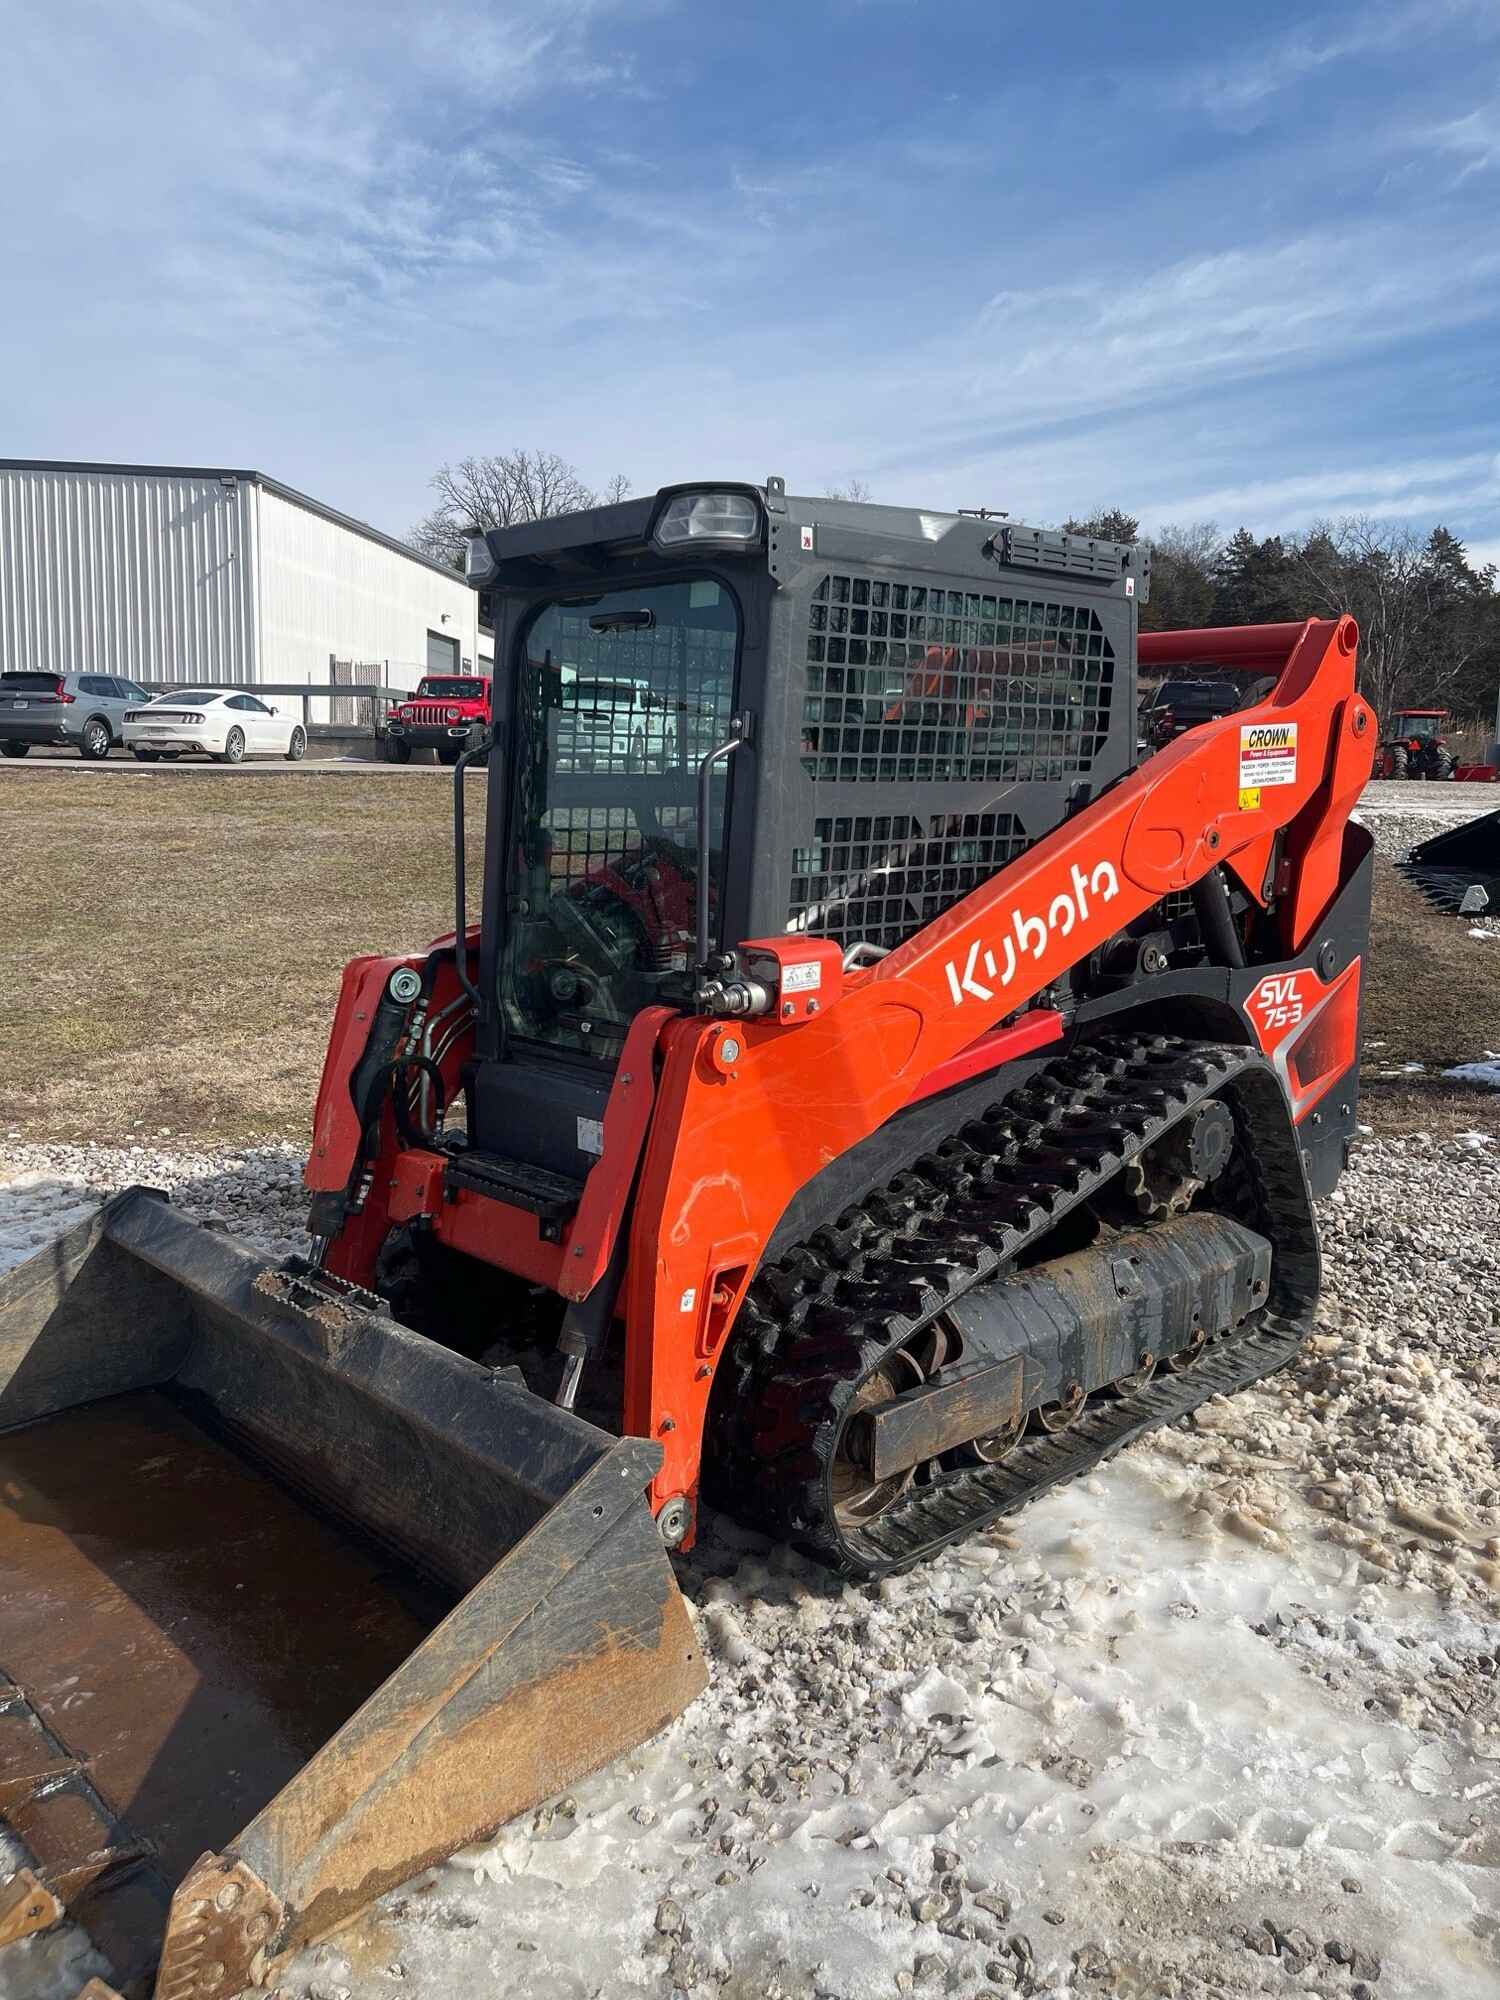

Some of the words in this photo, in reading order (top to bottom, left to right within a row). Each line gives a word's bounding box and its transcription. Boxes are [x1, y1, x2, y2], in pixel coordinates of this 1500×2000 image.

[1249, 728, 1289, 747] CROWN
[945, 861, 1119, 1008] Kubota
[1257, 977, 1302, 1008] SVL
[1264, 1003, 1303, 1030] 75-3
